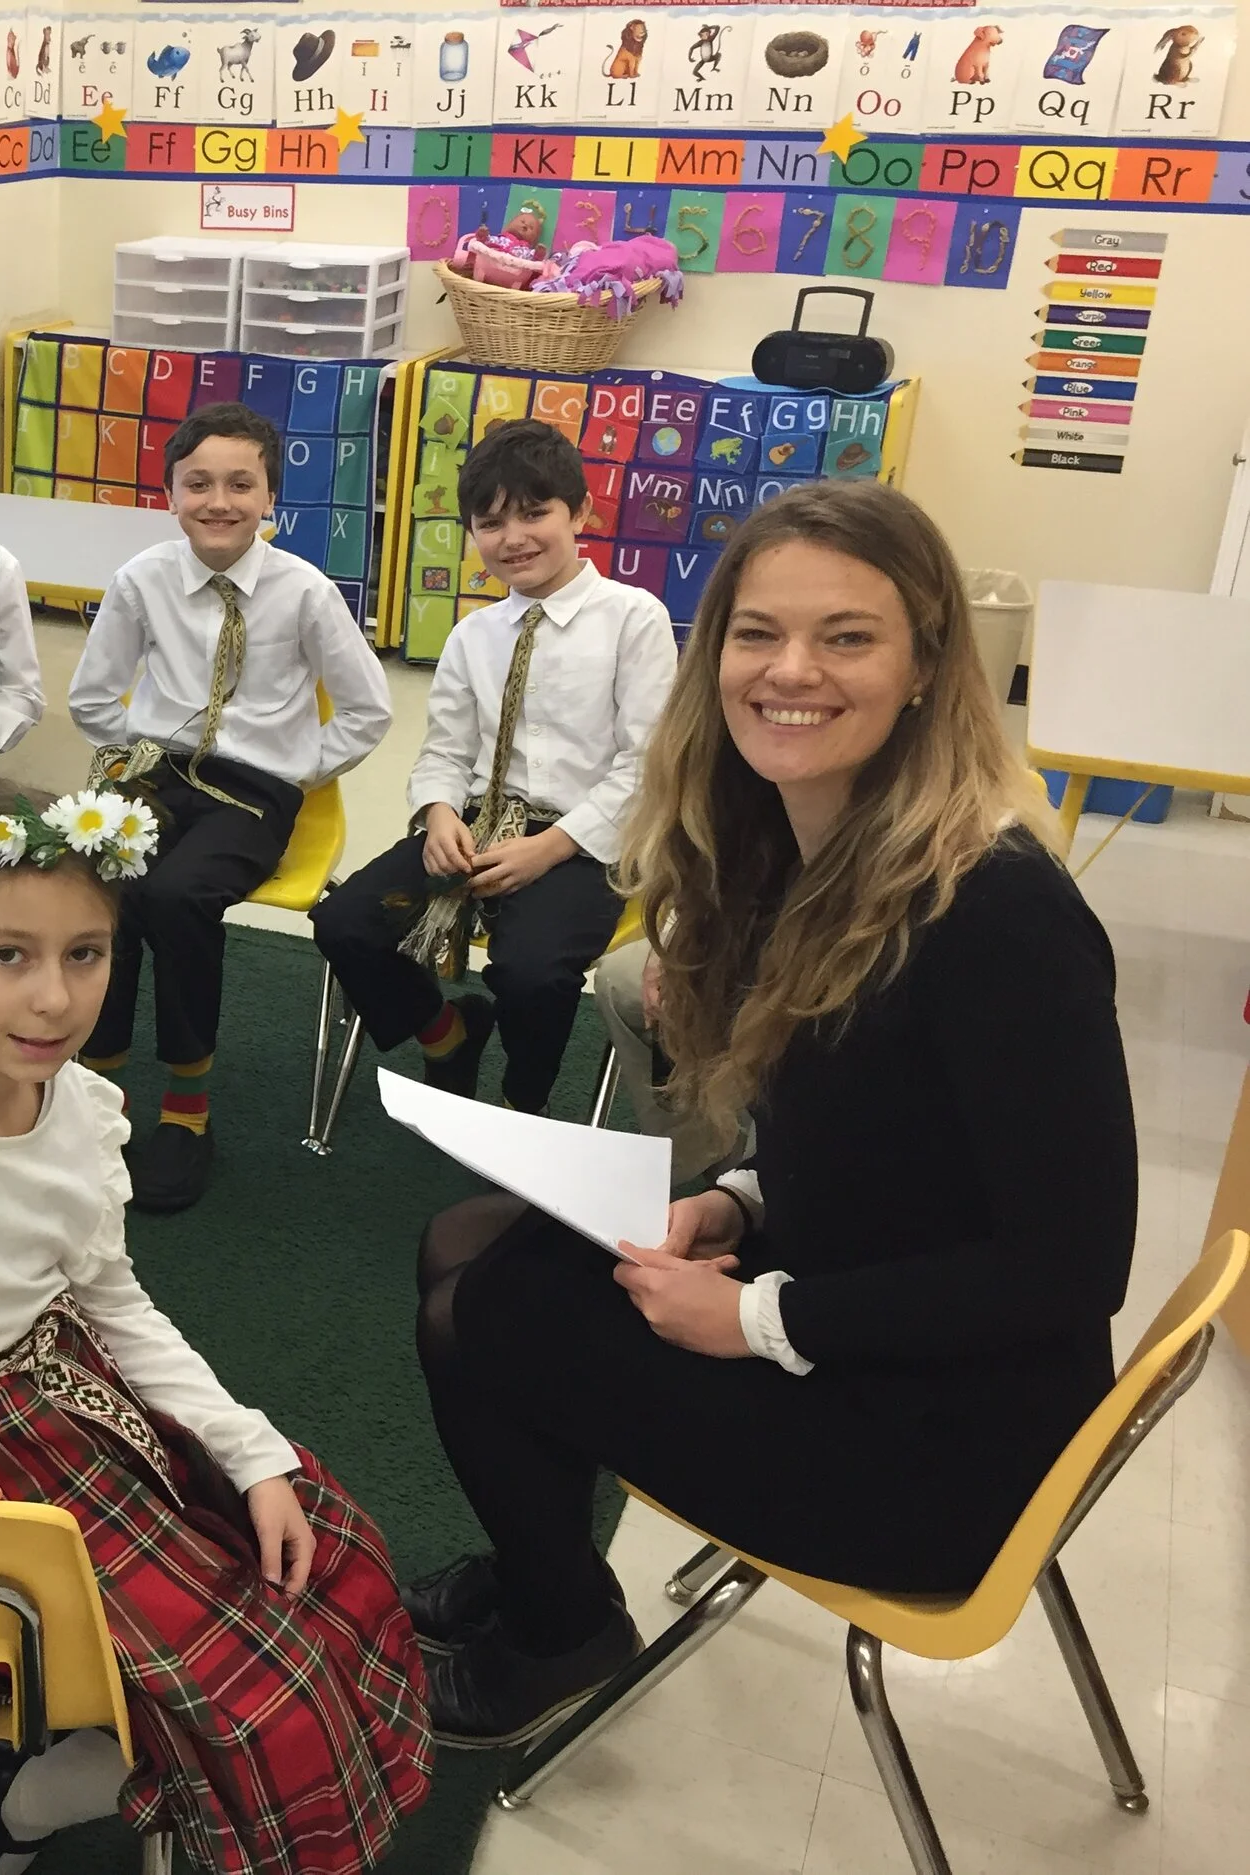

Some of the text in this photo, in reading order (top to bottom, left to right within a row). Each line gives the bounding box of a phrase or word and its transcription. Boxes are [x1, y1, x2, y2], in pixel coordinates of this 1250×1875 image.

[4, 86, 22, 108] Cc
[34, 80, 50, 104] Dd
[82, 82, 1195, 126] Ee Ff Gg Hh Ii Jj Kk Ll Mm Nn Oo Pp Qq Rr
[30, 126, 54, 162] Dd
[72, 130, 1192, 200] Ee Ff Gg Hh Ii Jj Kk Ll Mm Nn Oo Pp Qq Rr
[228, 206, 288, 221] Busy Bins
[678, 206, 709, 260] 5
[732, 204, 766, 255] 6
[793, 207, 826, 262] 7
[842, 206, 877, 268] 8
[902, 208, 937, 270] 9
[960, 220, 1010, 274] 10
[1094, 234, 1120, 247] Gray
[1090, 261, 1114, 272] Red
[1080, 288, 1112, 299] Yellow
[108, 351, 365, 396] C D E F G H
[1066, 384, 1090, 394] Blue
[538, 386, 880, 436] Cc Dd Ee Ff Gg Hh
[1063, 408, 1084, 417] Pink
[102, 421, 356, 466] K L O P
[1057, 430, 1084, 441] White
[1051, 454, 1080, 465] Black
[629, 472, 744, 507] Mm Nn
[272, 511, 348, 538] W X
[618, 550, 698, 580] U V
